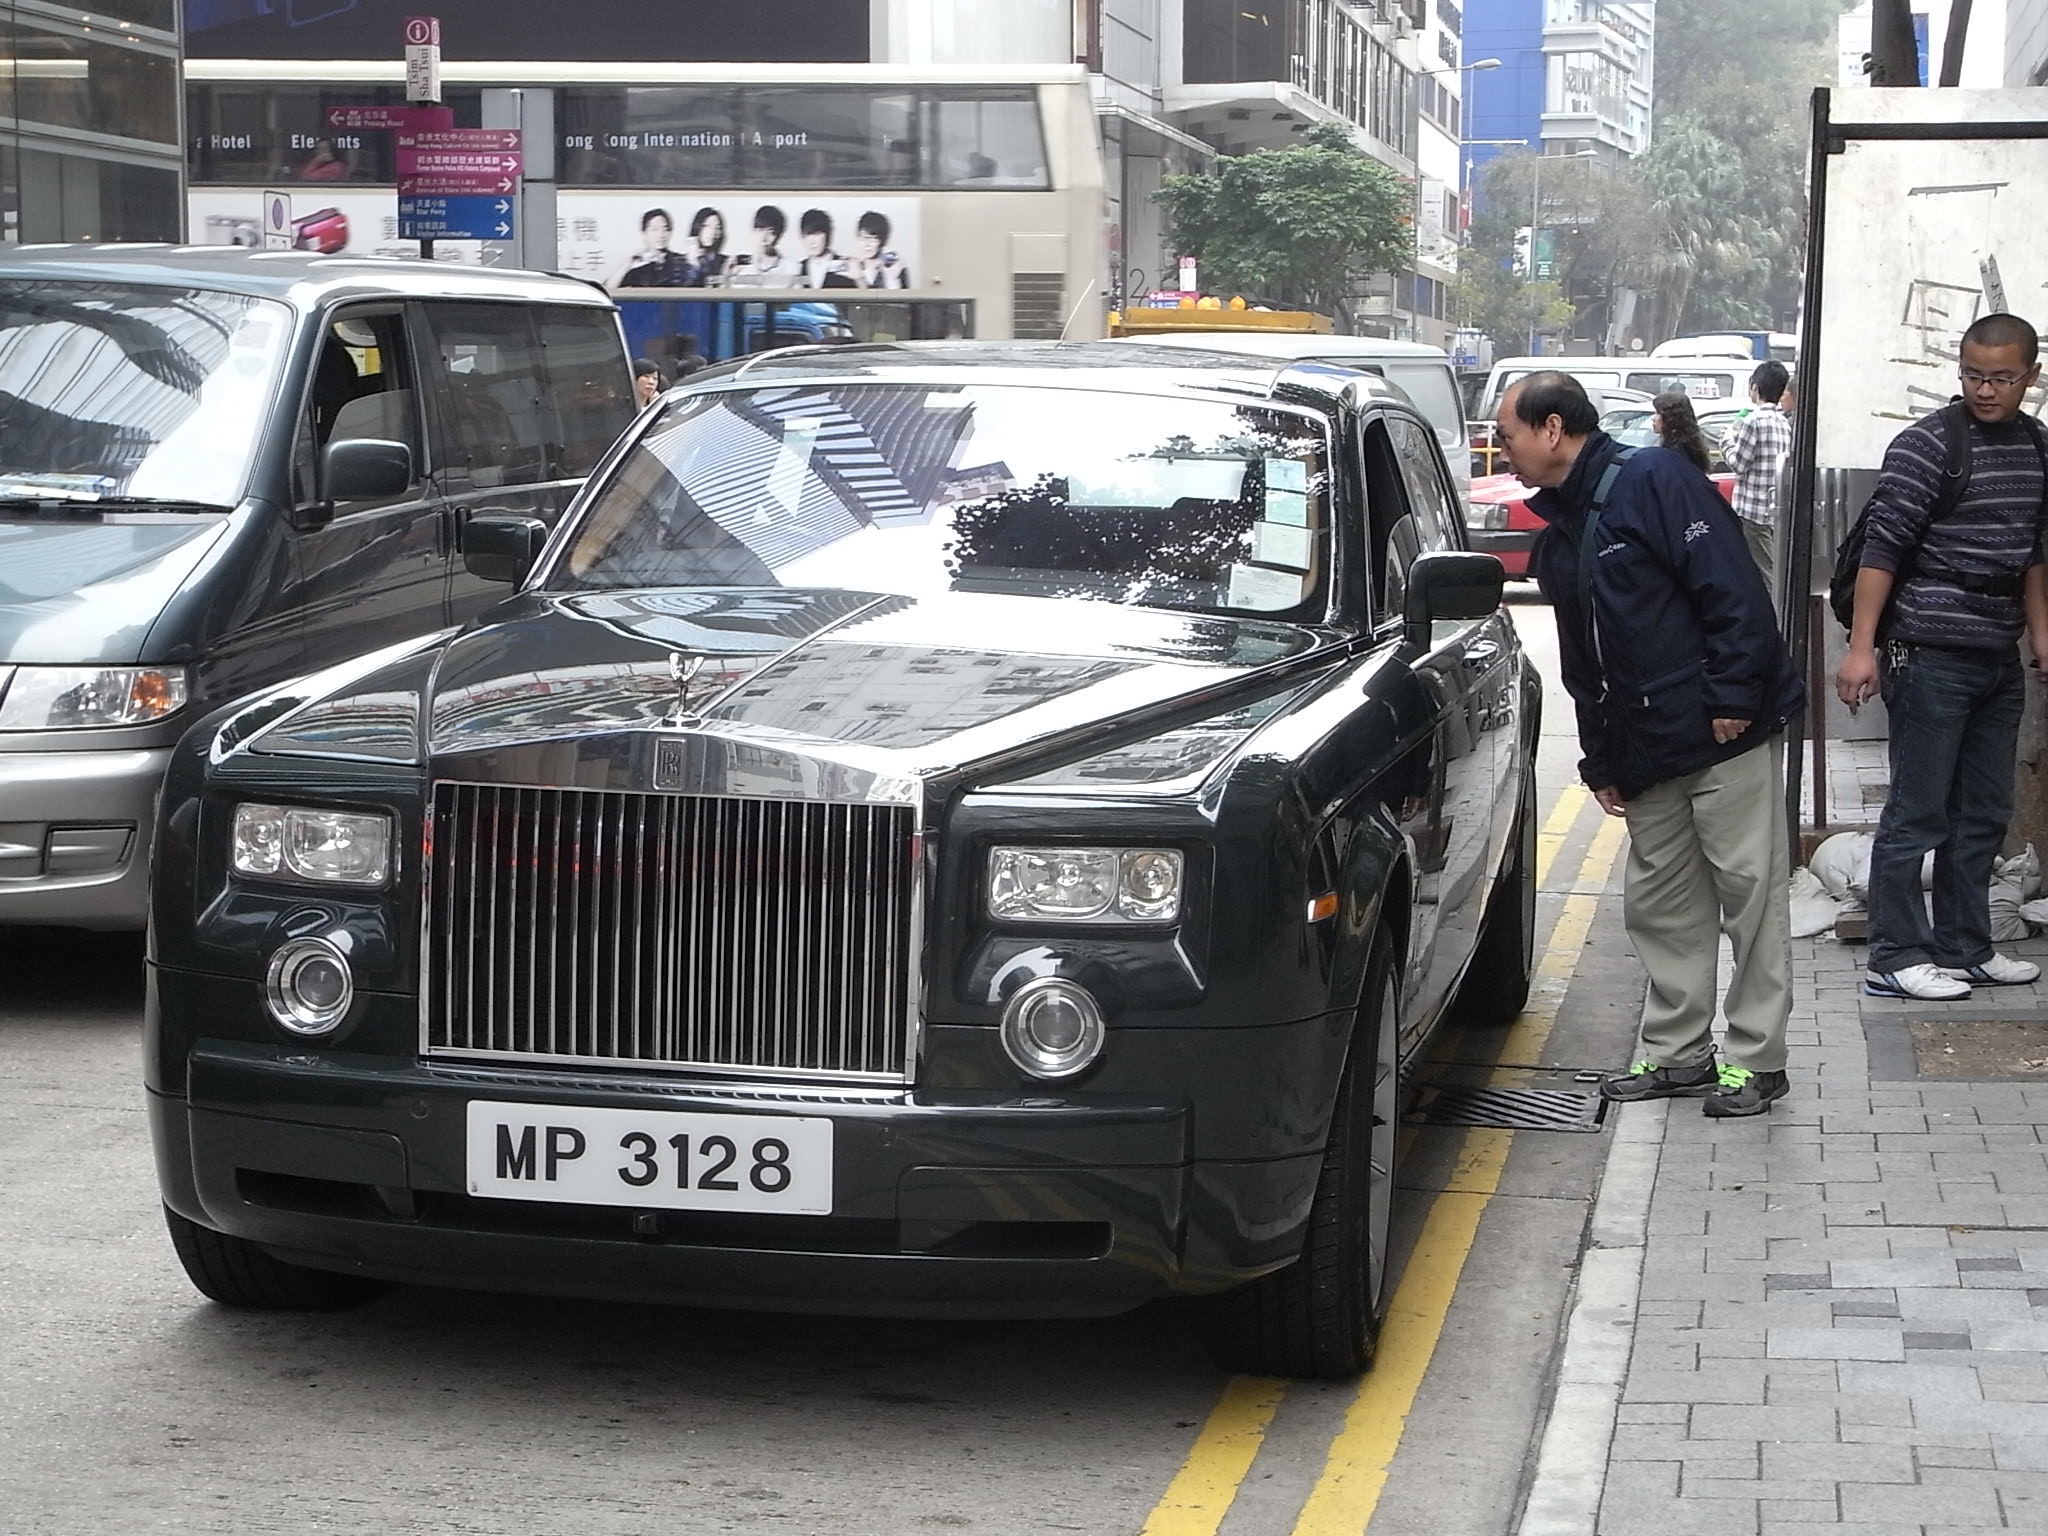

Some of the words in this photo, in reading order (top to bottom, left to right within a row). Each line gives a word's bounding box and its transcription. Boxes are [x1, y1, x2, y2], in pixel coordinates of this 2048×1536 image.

[418, 48, 429, 72] Tsui
[408, 58, 419, 87] Tsim
[419, 76, 430, 97] Sha
[211, 133, 251, 149] Hotel
[291, 133, 361, 149] Elents
[565, 134, 594, 150] ong
[603, 132, 639, 150] ong
[752, 130, 808, 149] Aport
[430, 208, 446, 216] Ferry
[495, 1123, 587, 1182] MP
[617, 1130, 792, 1193] 3128
